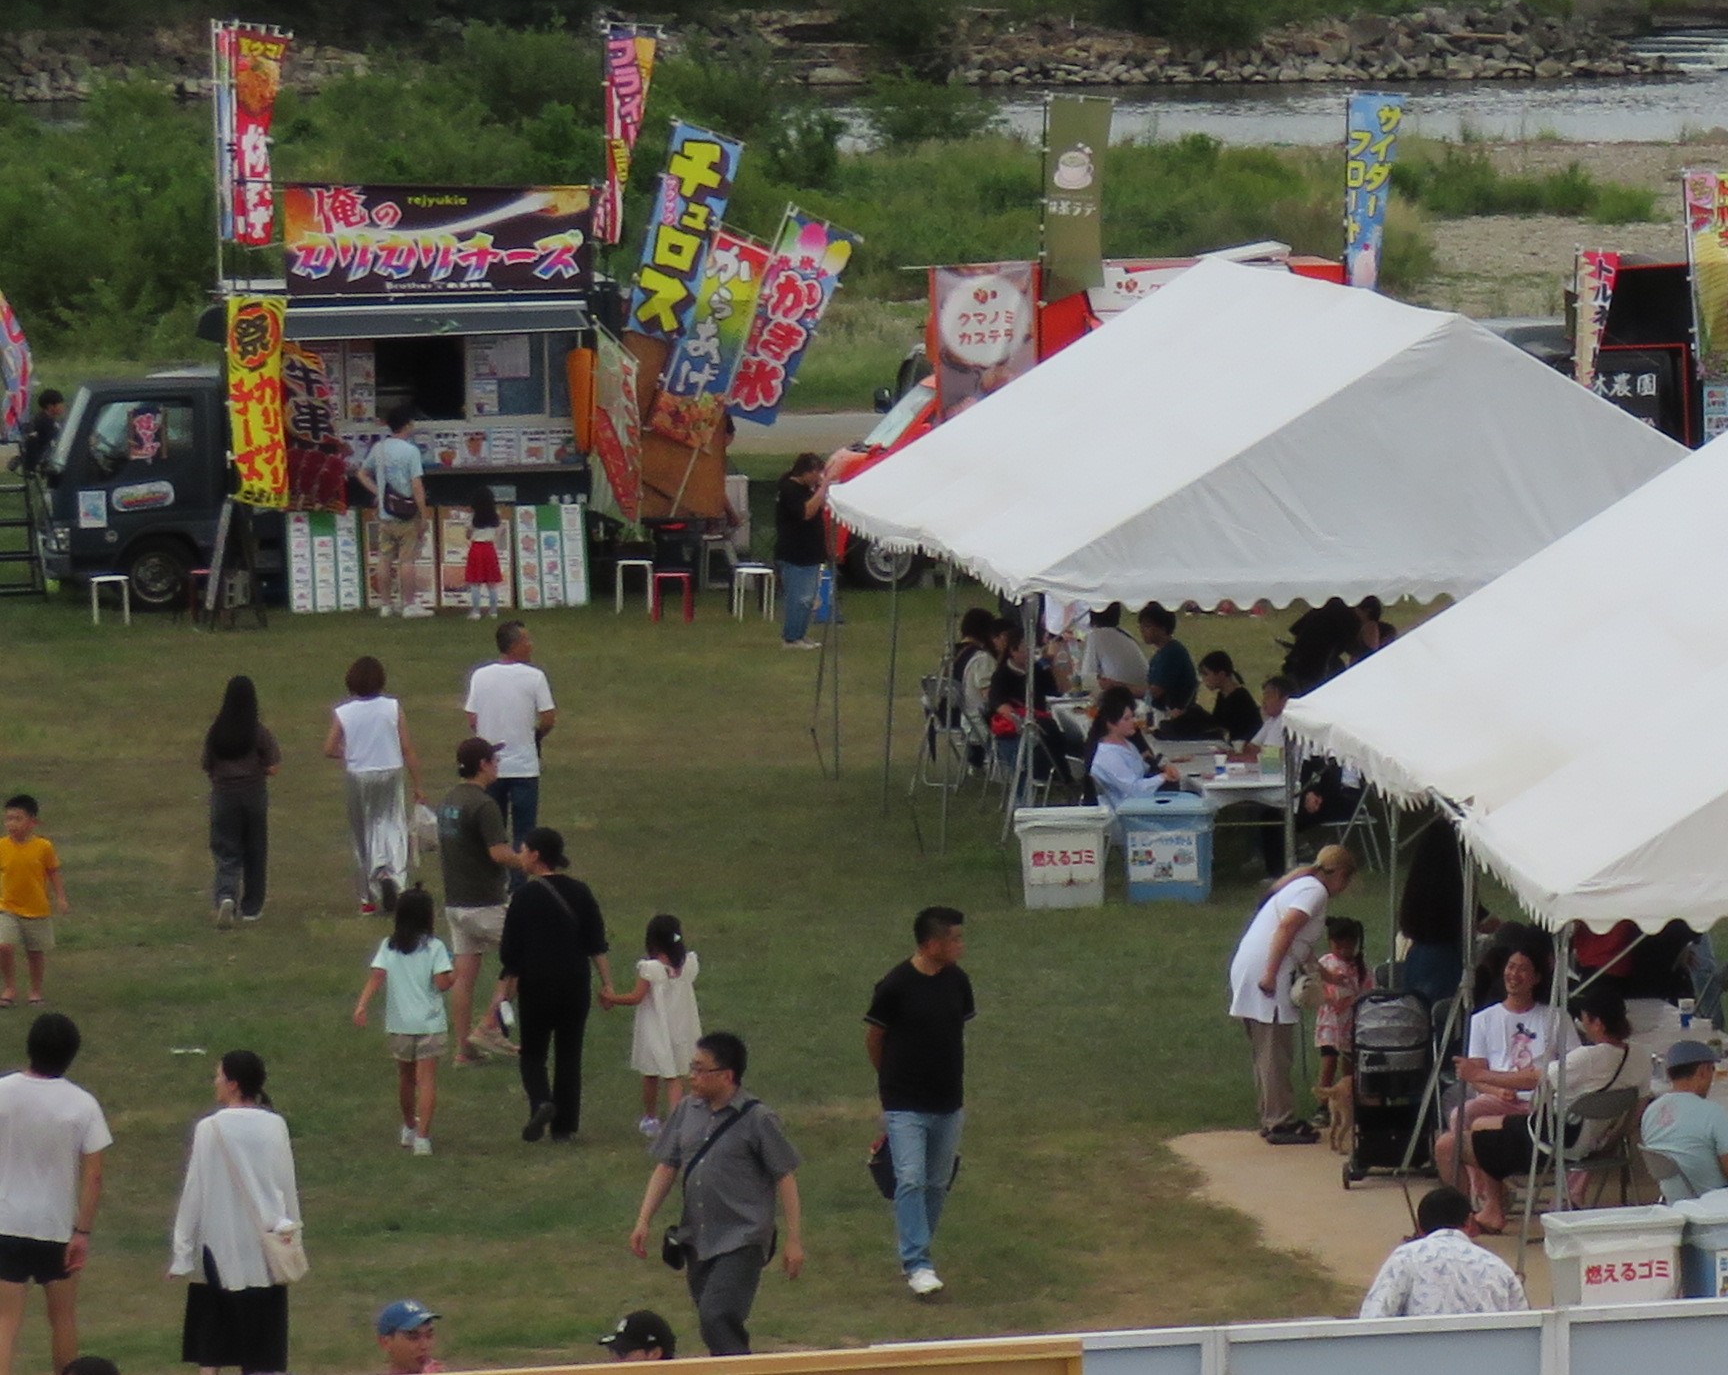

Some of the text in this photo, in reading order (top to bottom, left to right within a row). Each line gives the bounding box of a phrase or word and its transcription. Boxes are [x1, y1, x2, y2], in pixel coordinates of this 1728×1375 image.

[1347, 130, 1373, 245] フロート
[1369, 105, 1402, 219] サイダー
[312, 187, 402, 235] 俺の
[635, 137, 722, 332] チュロス
[291, 228, 584, 283] カリカリチーズ
[232, 313, 271, 360] 祭
[675, 245, 752, 394] からあげ
[729, 270, 824, 411] かき氷
[958, 309, 1015, 327] クマノミ
[958, 328, 1015, 345] カステラ
[1031, 849, 1096, 868] 燃えるゴミ
[1584, 1259, 1671, 1286] 燃えるゴミ
